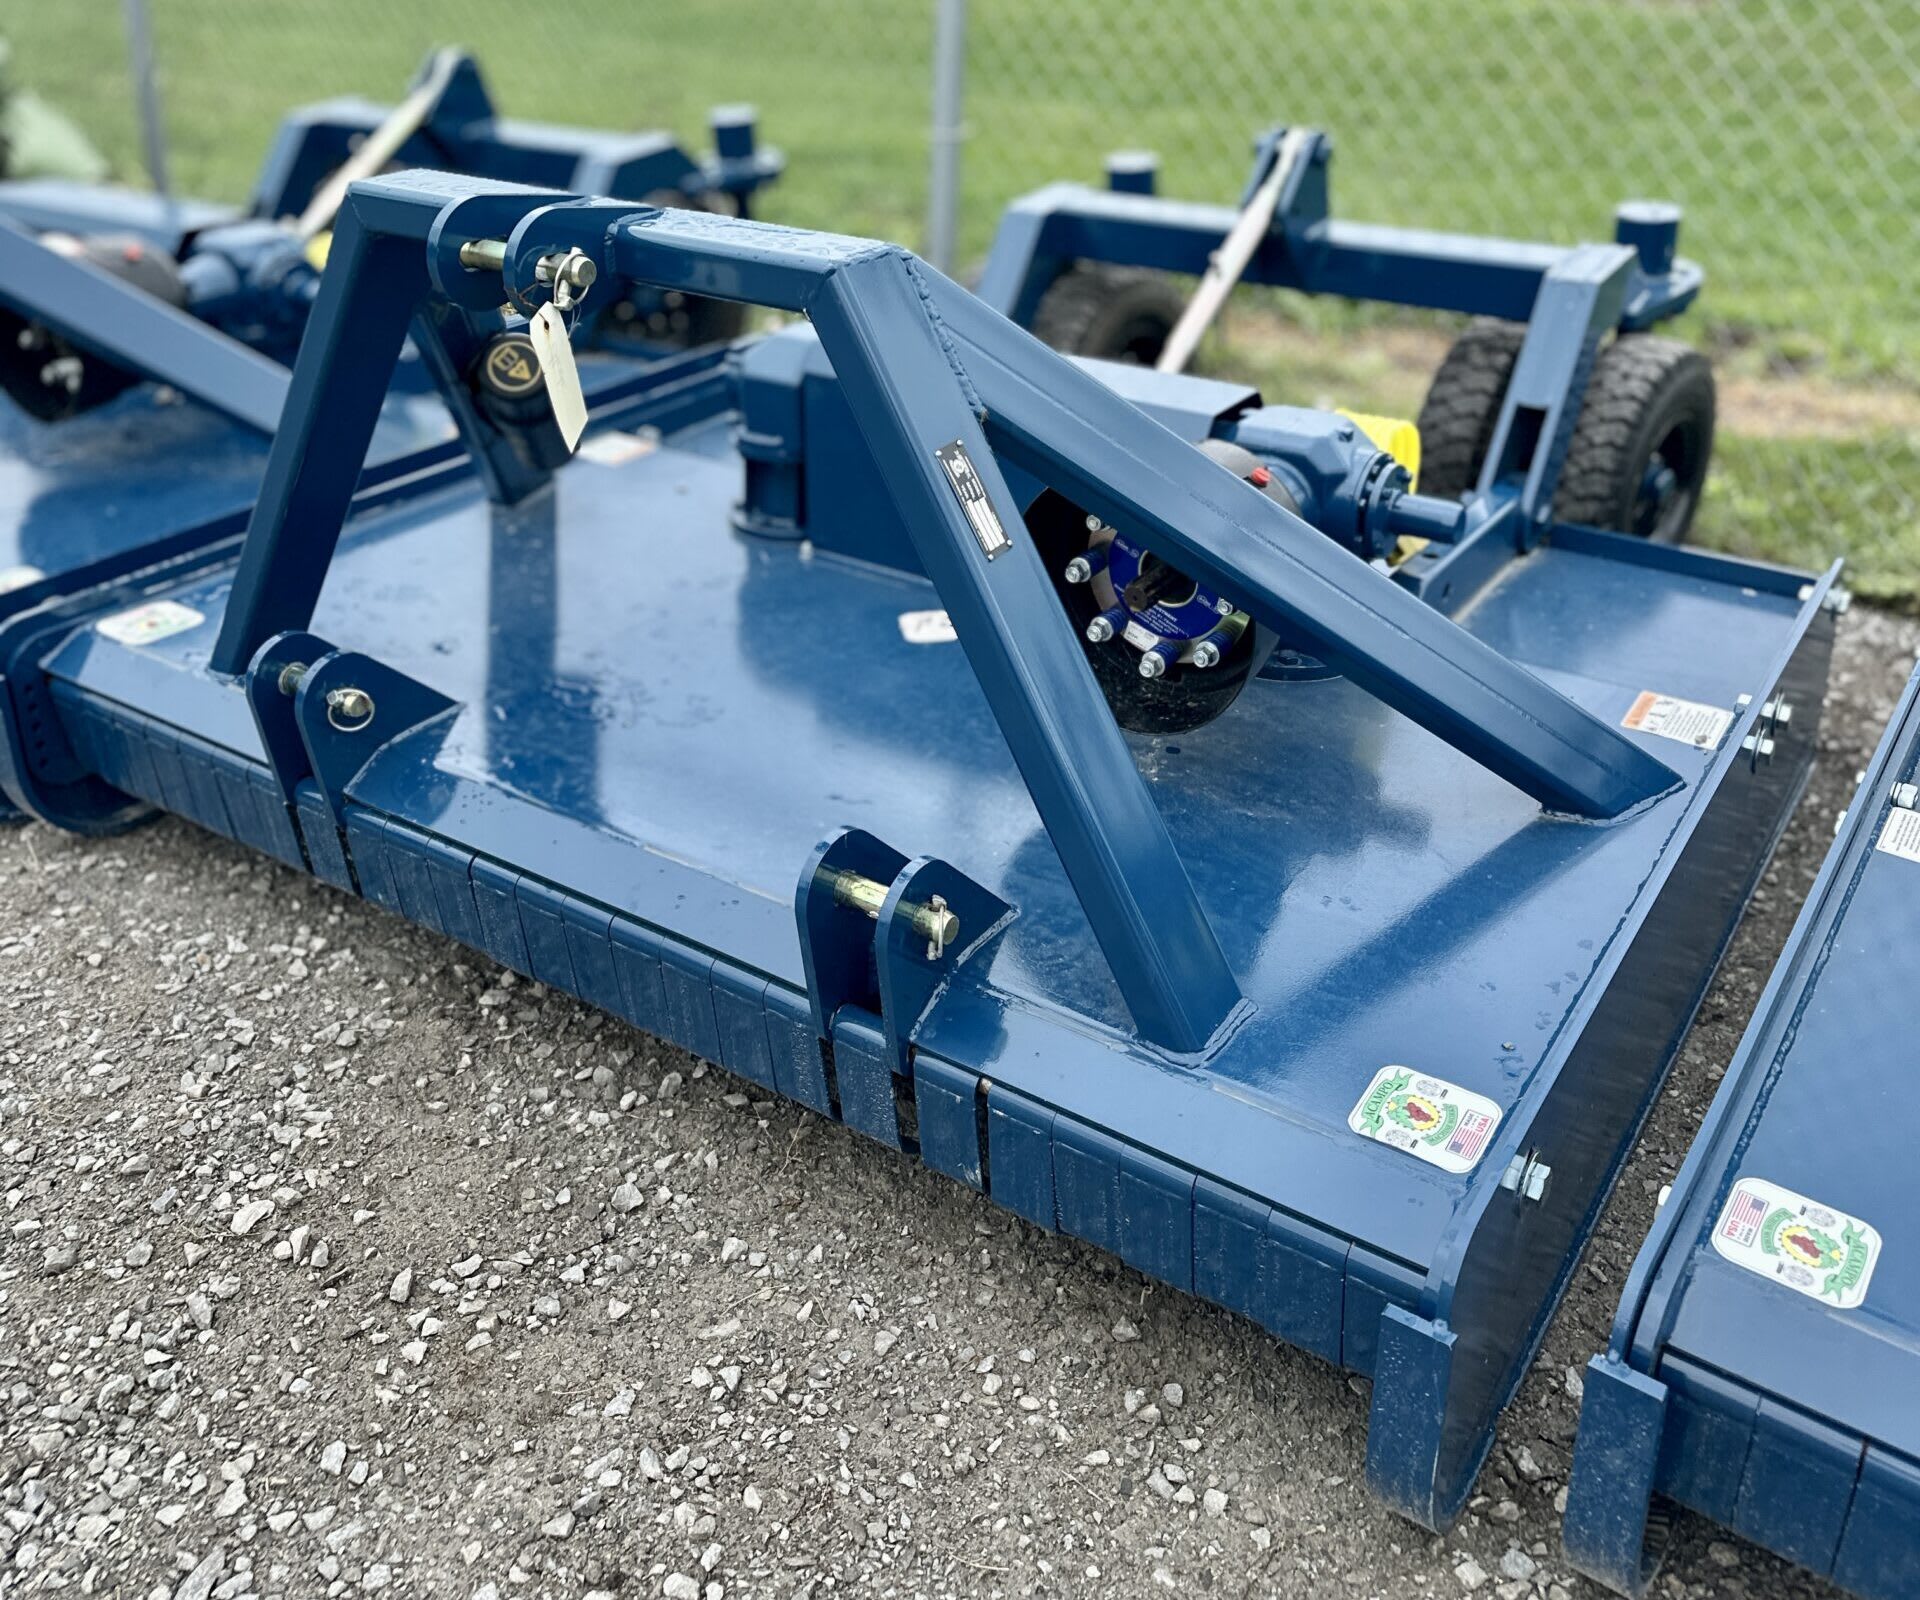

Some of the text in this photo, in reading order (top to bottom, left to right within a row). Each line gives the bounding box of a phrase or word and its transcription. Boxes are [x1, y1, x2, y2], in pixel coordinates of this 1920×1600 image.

[1365, 1081, 1393, 1118] ACAMPO
[1463, 1113, 1474, 1127] MADE
[1475, 1116, 1490, 1133] USA
[1726, 1220, 1740, 1237] USA
[1743, 1227, 1754, 1243] MADE
[1841, 1242, 1866, 1286] ACAMPO
